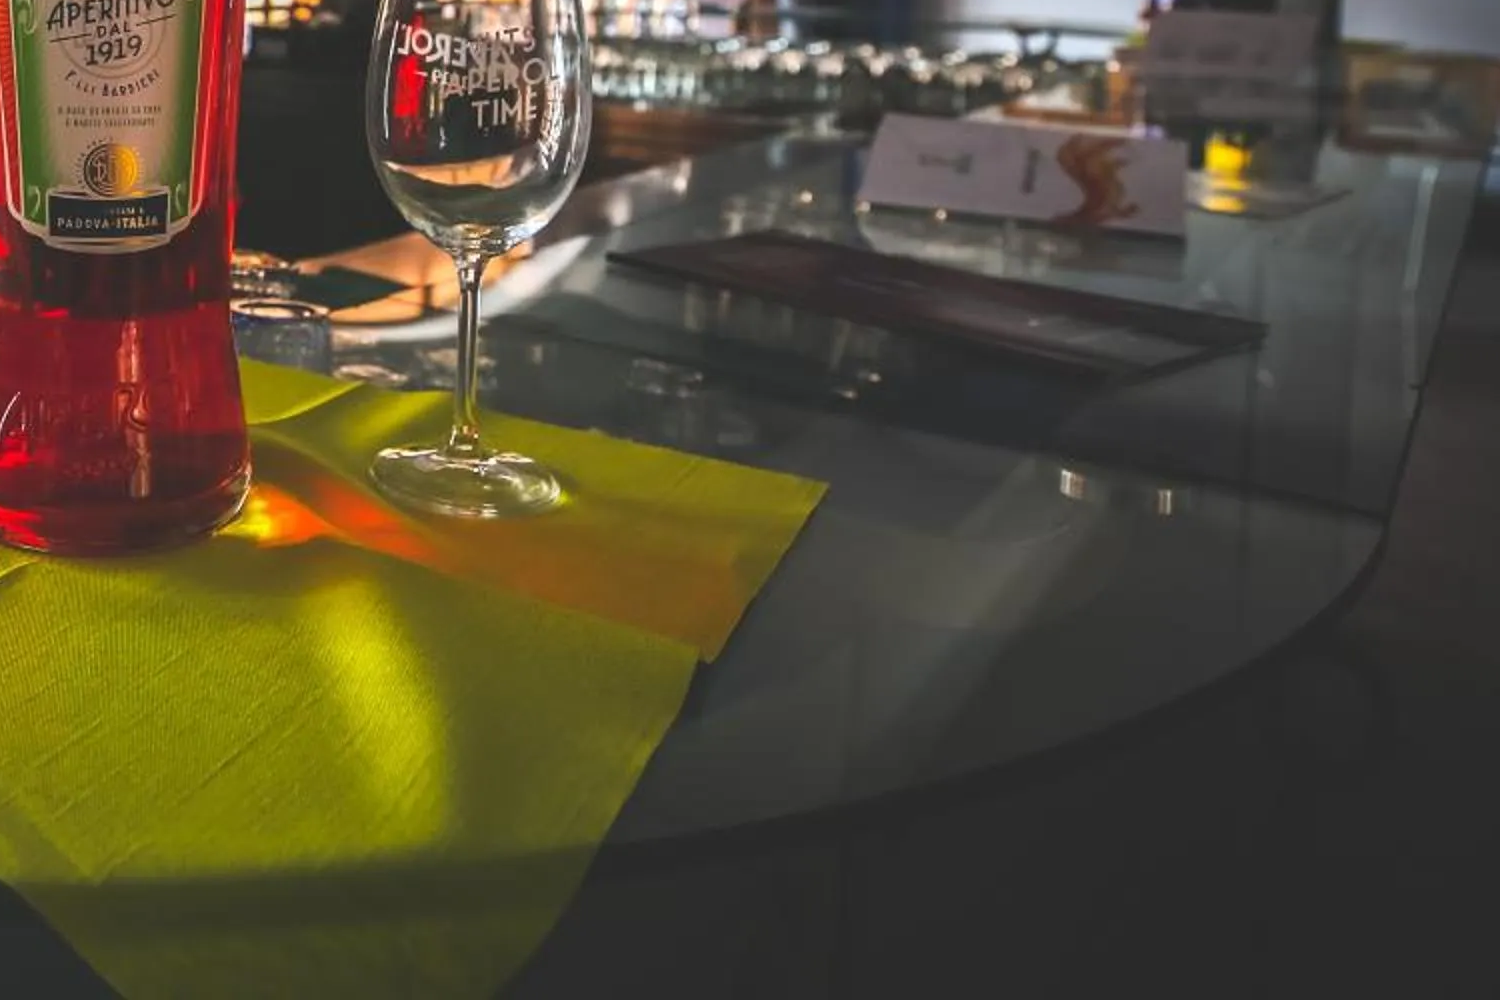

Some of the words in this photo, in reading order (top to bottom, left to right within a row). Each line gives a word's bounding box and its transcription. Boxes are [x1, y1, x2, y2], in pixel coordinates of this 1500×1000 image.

[96, 21, 131, 38] DAL
[85, 35, 142, 66] 1919
[471, 92, 537, 129] TIME
